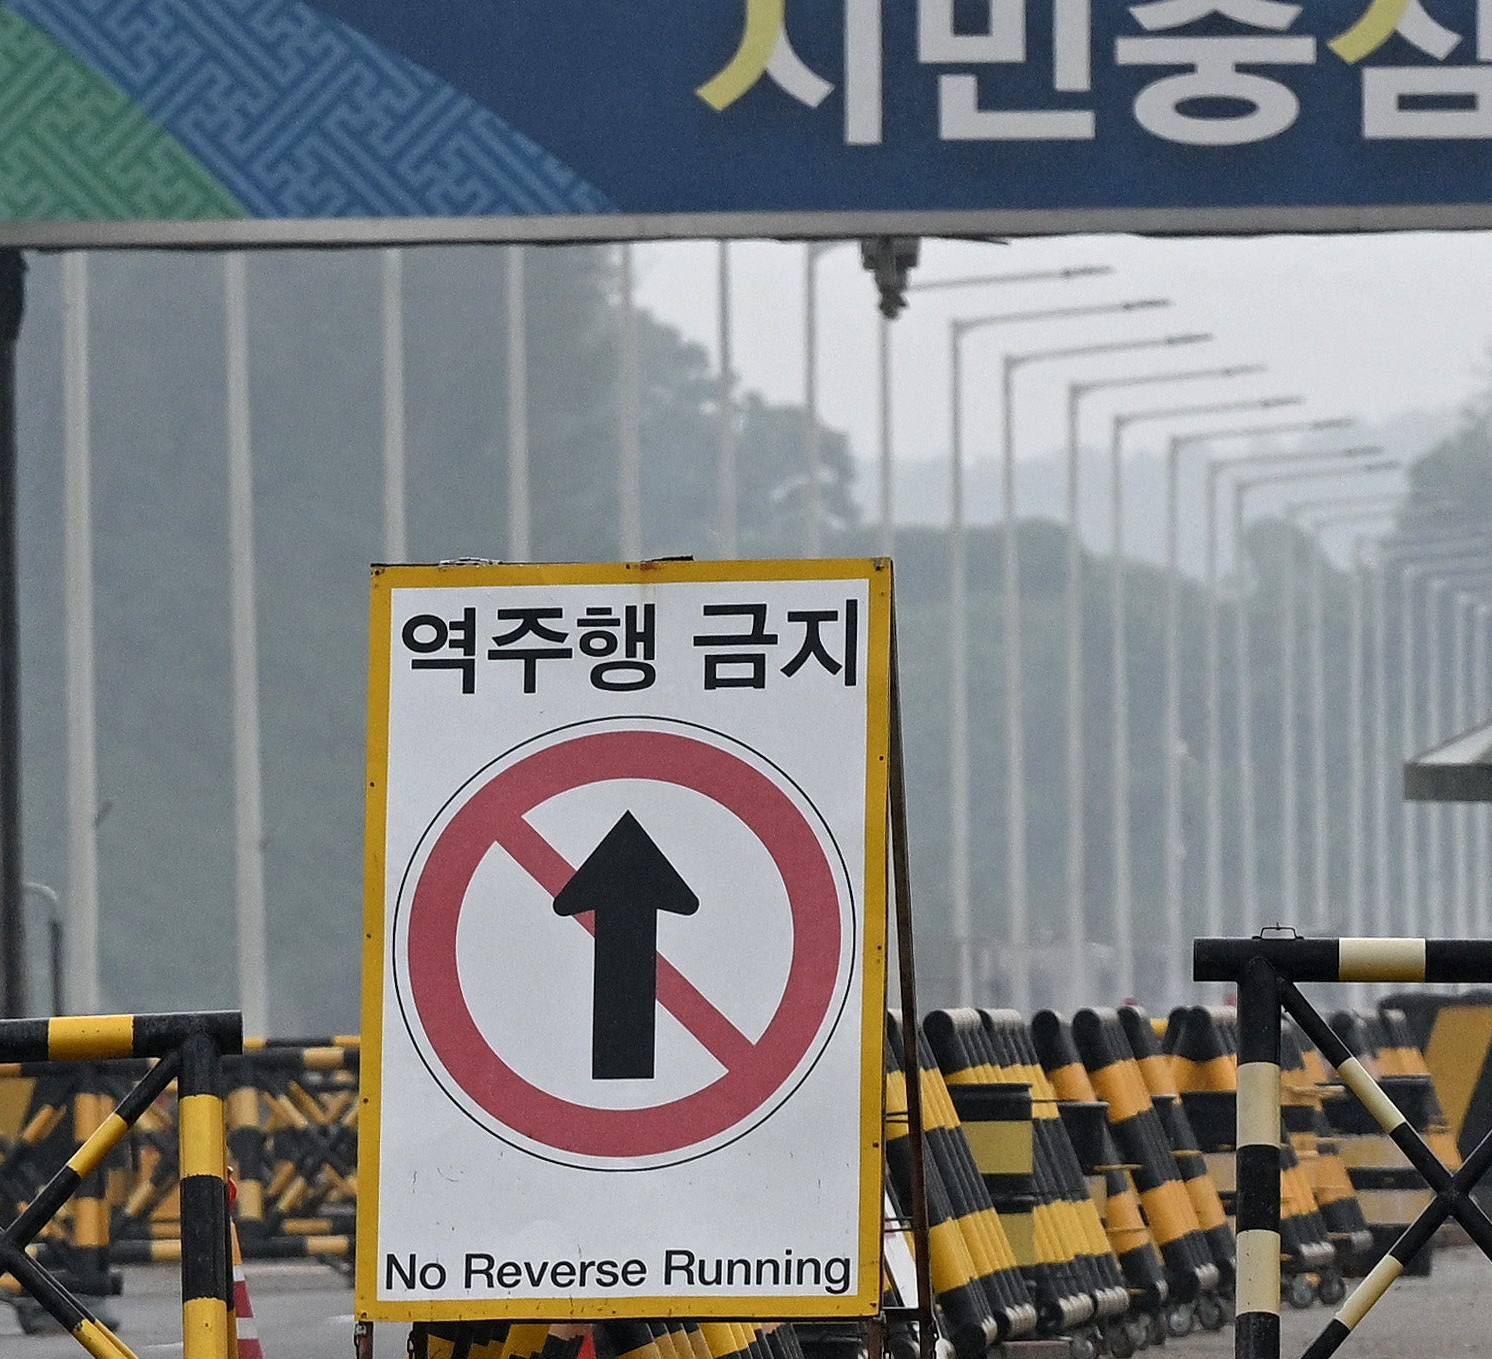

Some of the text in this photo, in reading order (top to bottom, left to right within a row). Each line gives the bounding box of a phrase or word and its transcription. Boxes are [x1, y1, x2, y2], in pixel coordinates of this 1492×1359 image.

[401, 598, 858, 694] 역주행 금지
[384, 1249, 852, 1295] No Reverse Running
